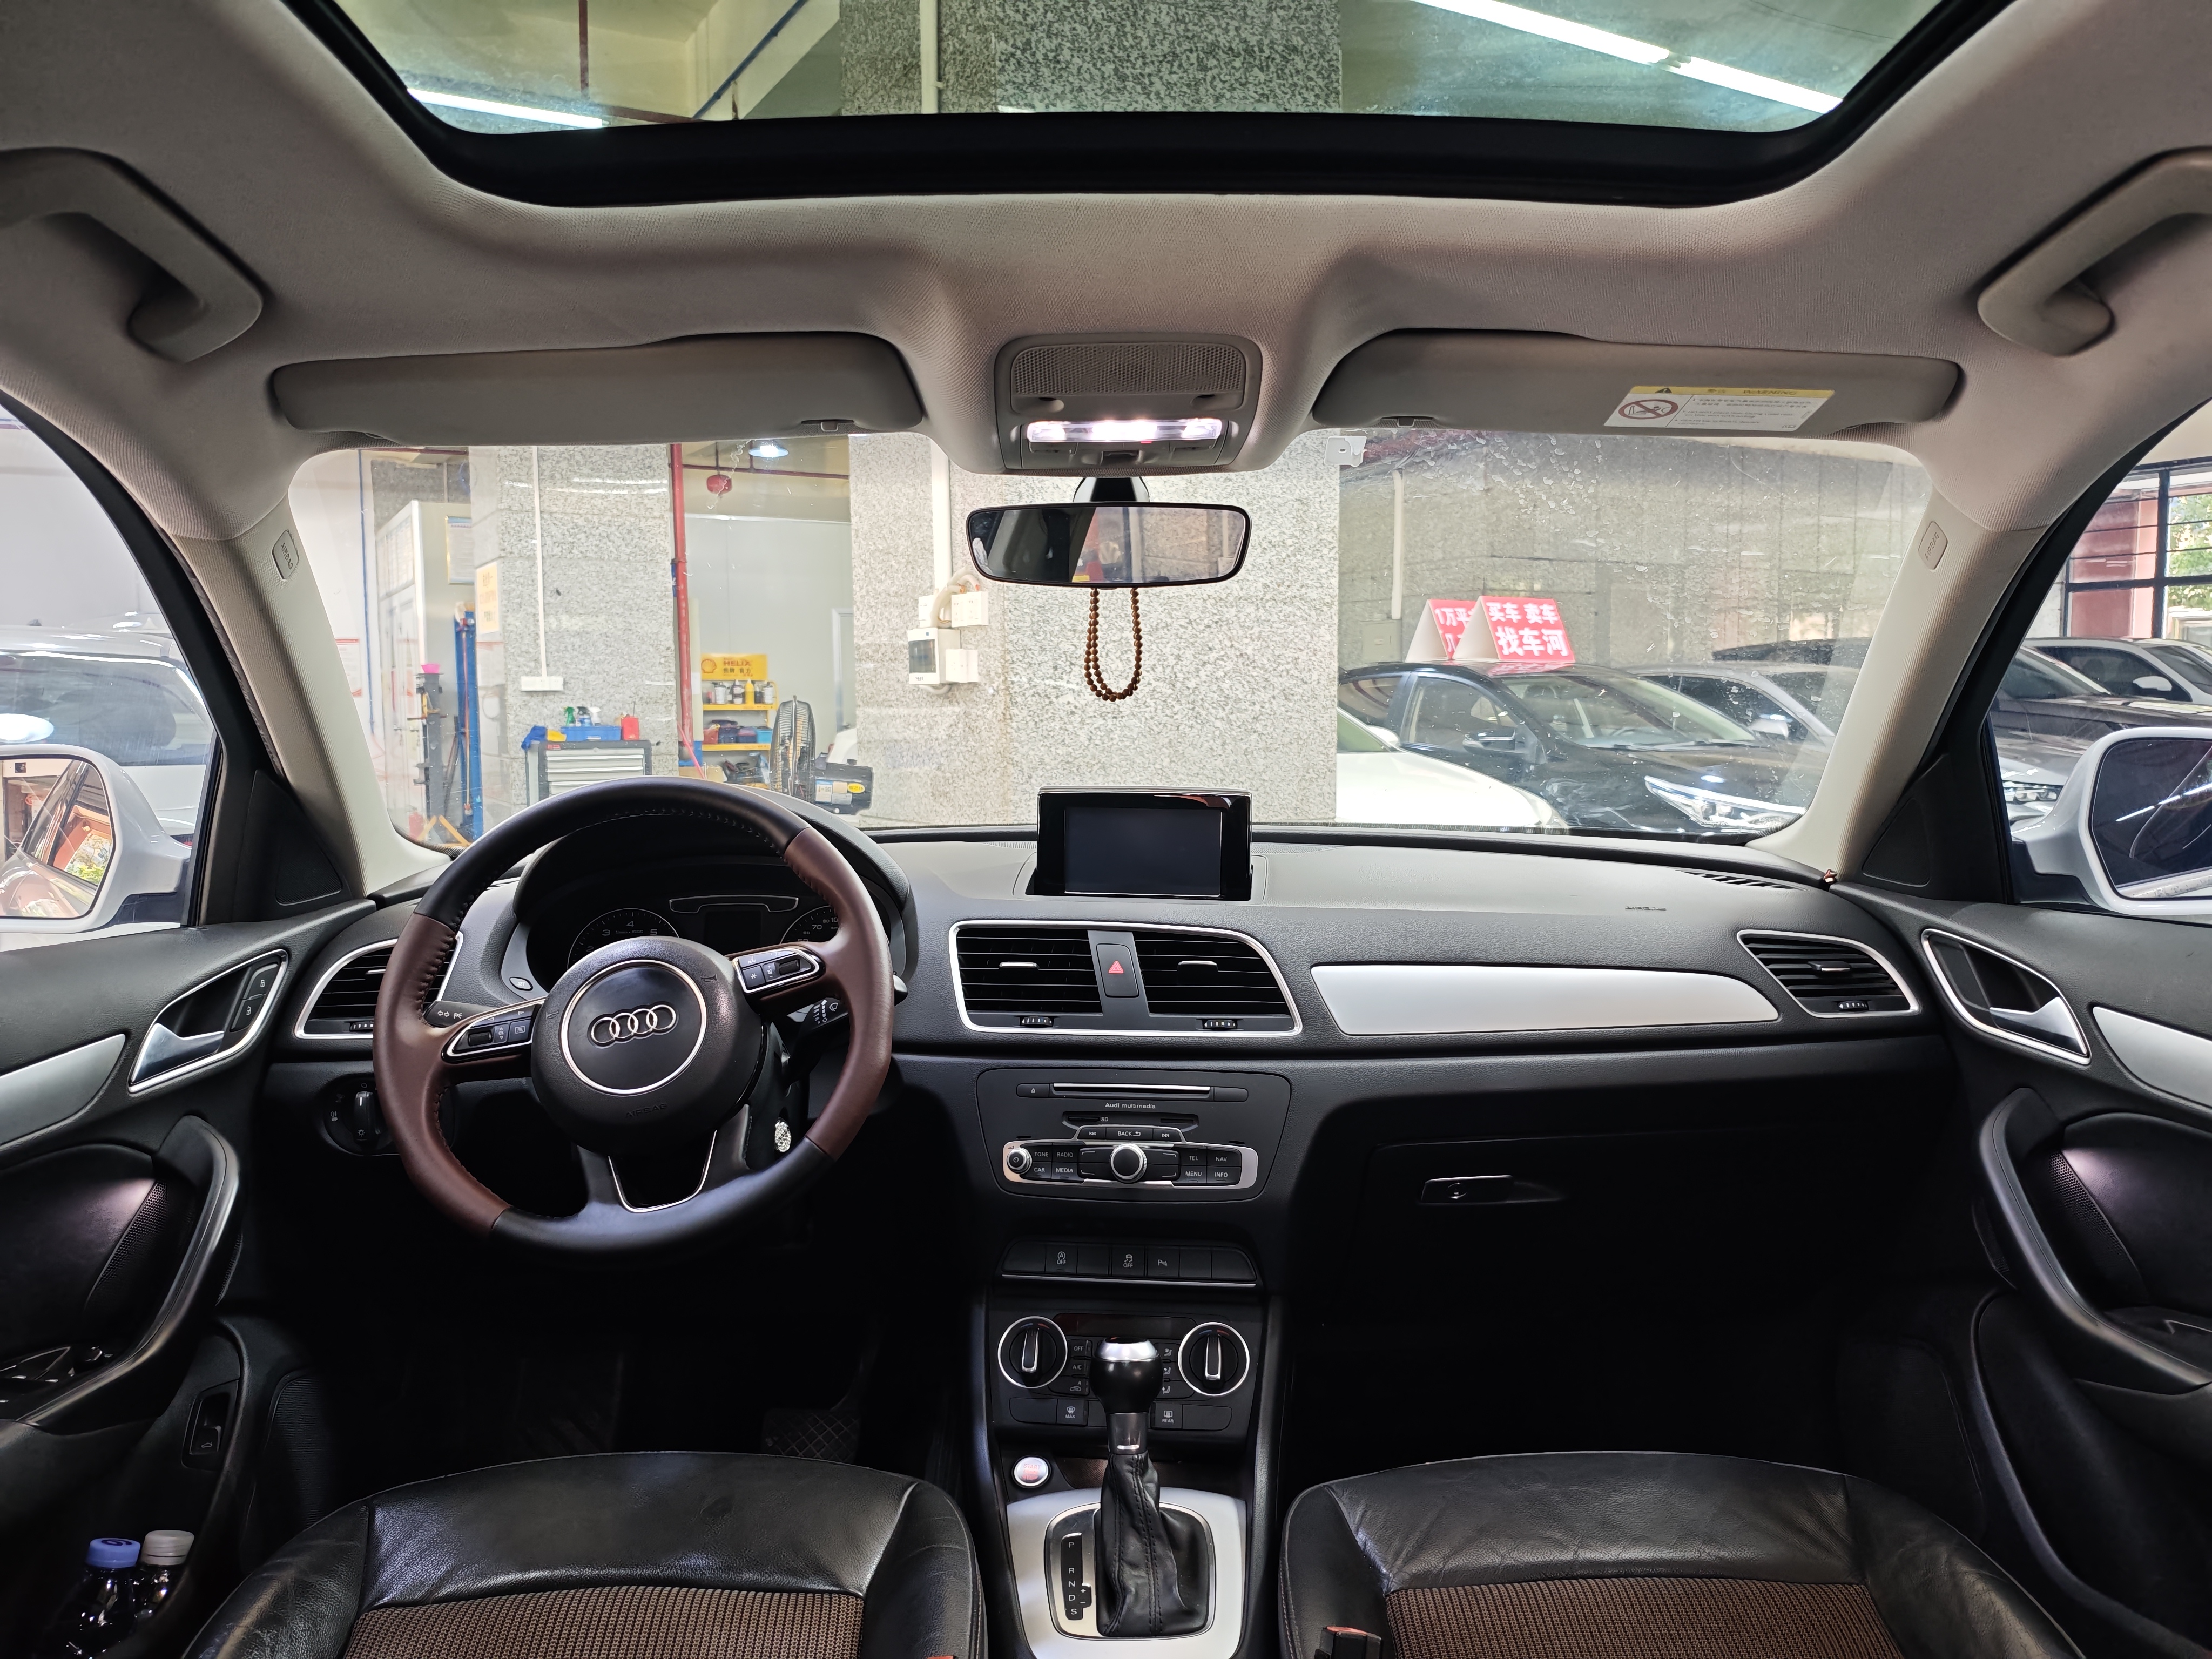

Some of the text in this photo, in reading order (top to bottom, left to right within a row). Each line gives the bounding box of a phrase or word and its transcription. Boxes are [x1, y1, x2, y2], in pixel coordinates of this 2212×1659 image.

[281, 542, 293, 570] AIRBAG
[1434, 607, 1475, 628] 1万平
[1486, 602, 1559, 624] 买车 卖车
[1495, 626, 1568, 657] 找车河
[626, 1103, 667, 1117] AIRBAG
